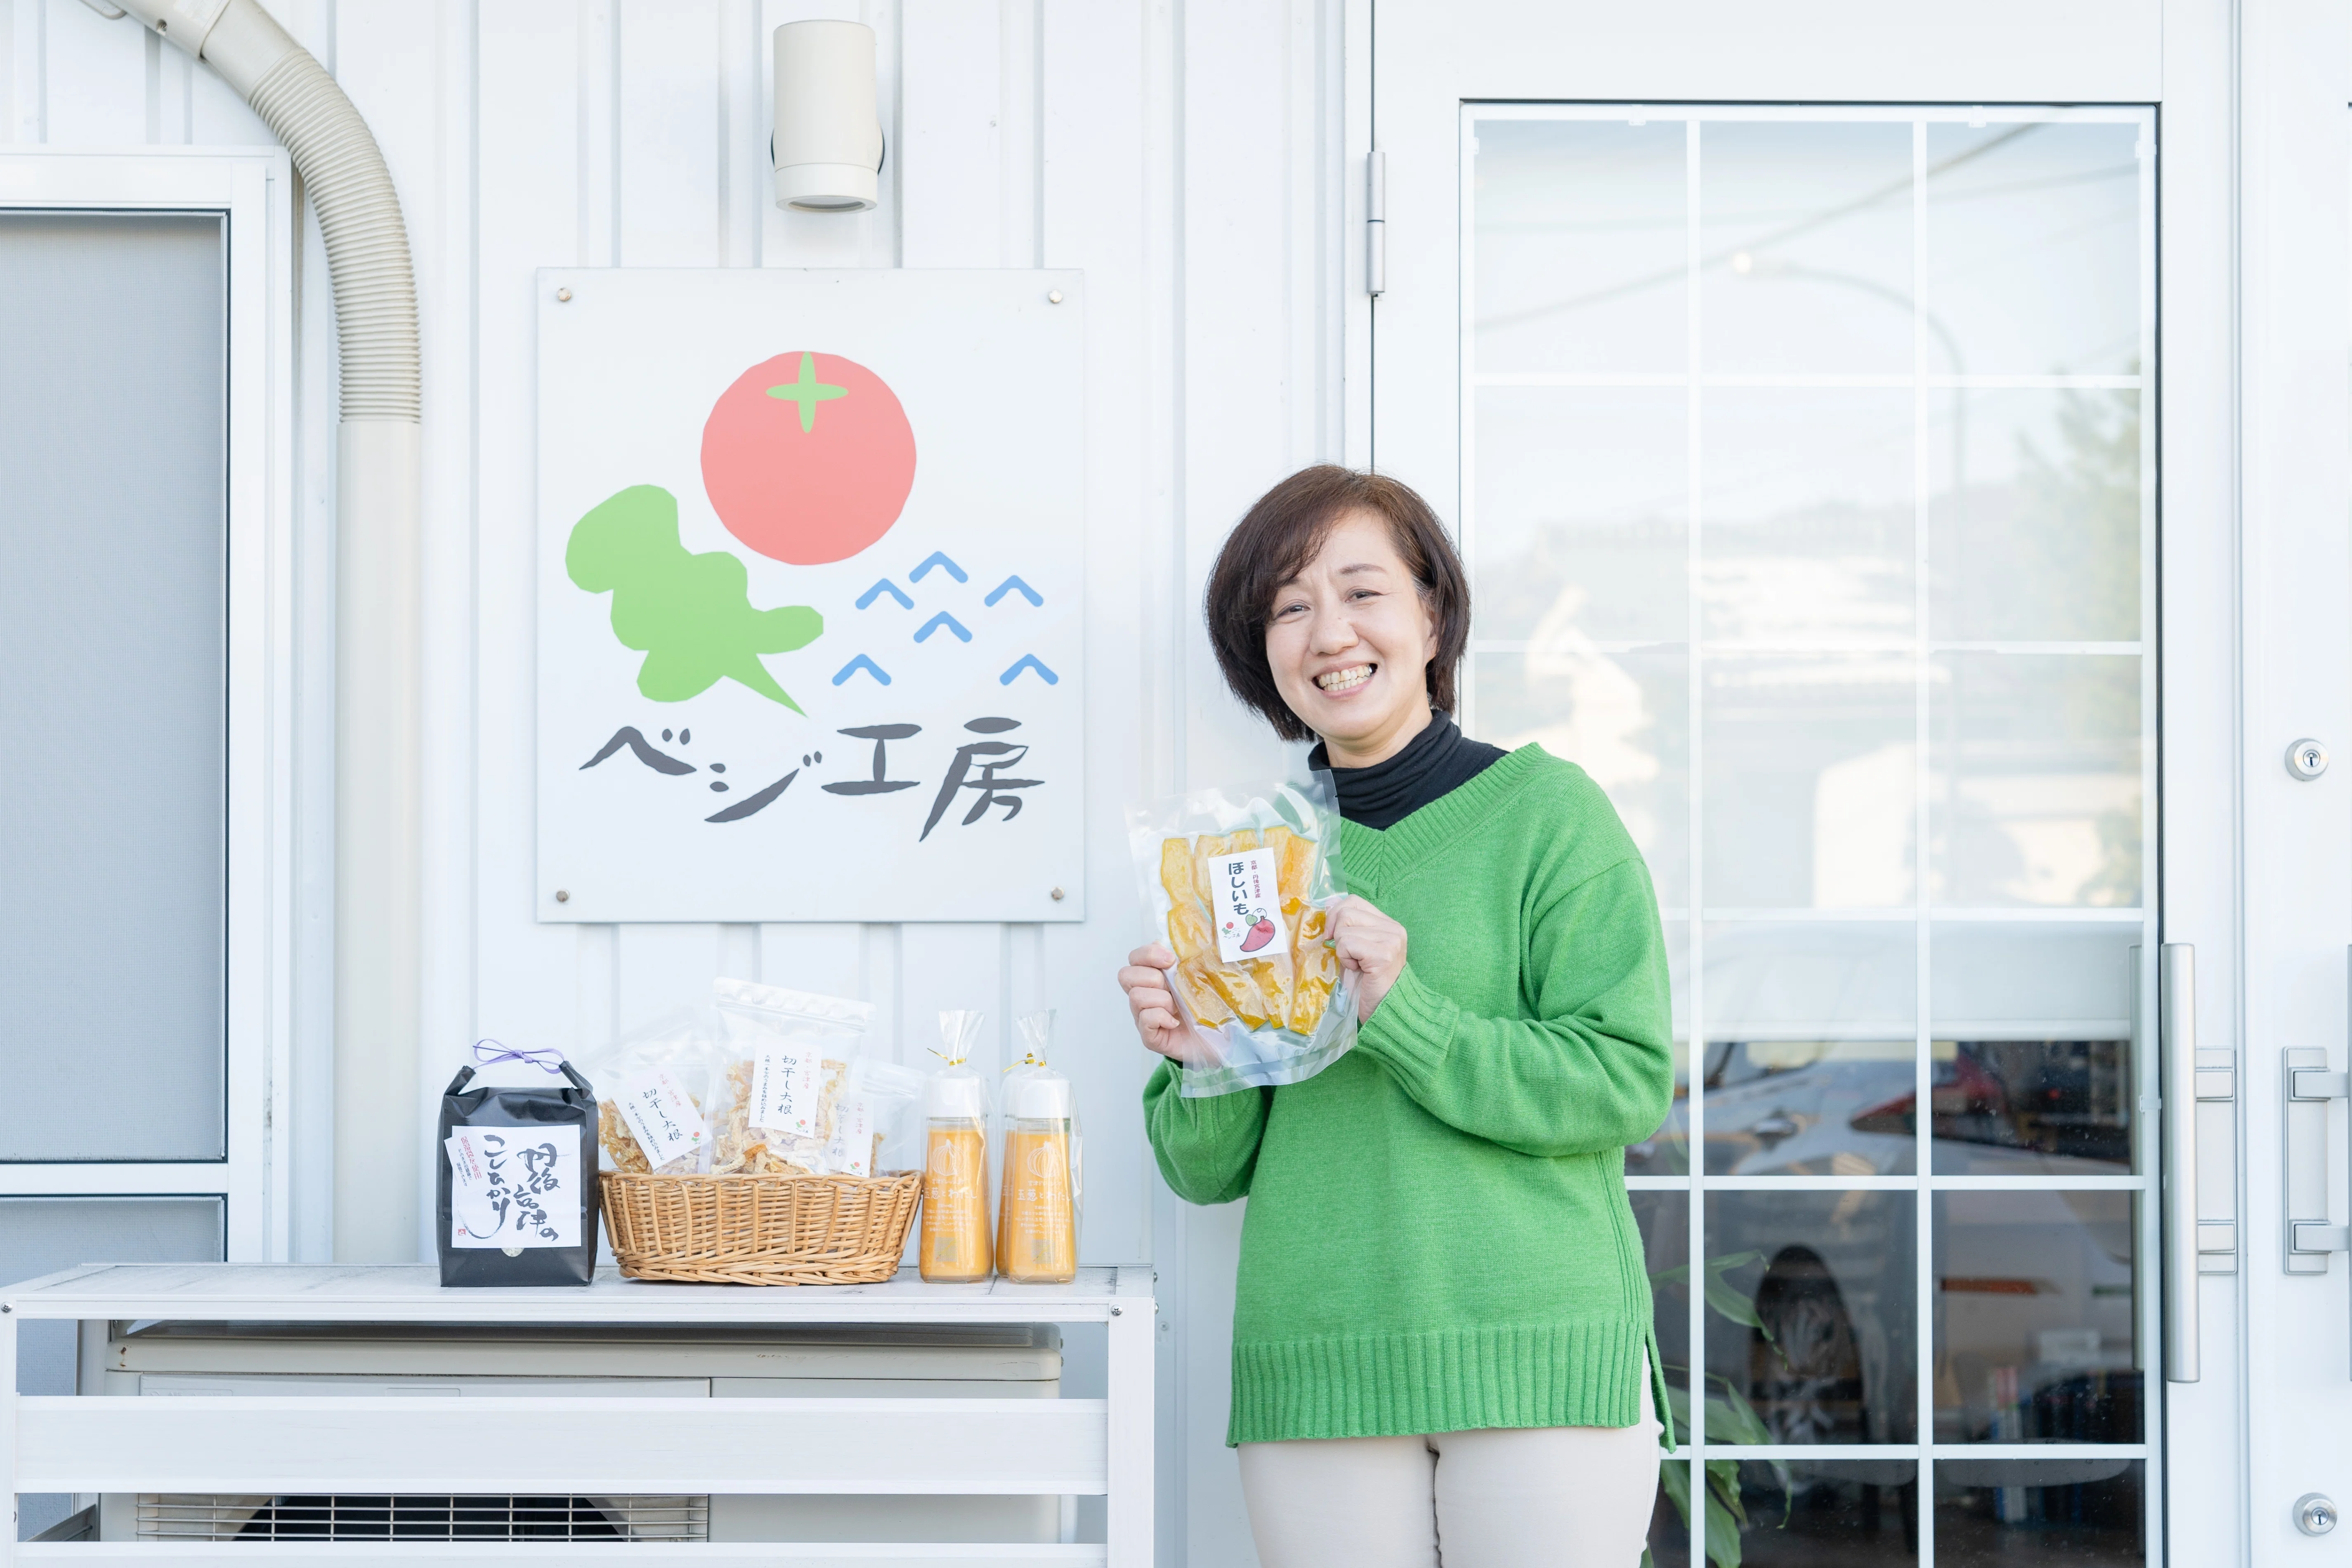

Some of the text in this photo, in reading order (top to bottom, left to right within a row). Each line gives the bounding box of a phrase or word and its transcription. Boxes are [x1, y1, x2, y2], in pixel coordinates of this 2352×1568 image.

[579, 717, 1045, 842] ベジ工房
[1228, 862, 1249, 915] ほしいも
[642, 1088, 683, 1141] 切干し大根
[777, 1055, 797, 1115] 切干し大根
[464, 1134, 511, 1239] こしひかり
[513, 1143, 566, 1242] 丹後宮津の
